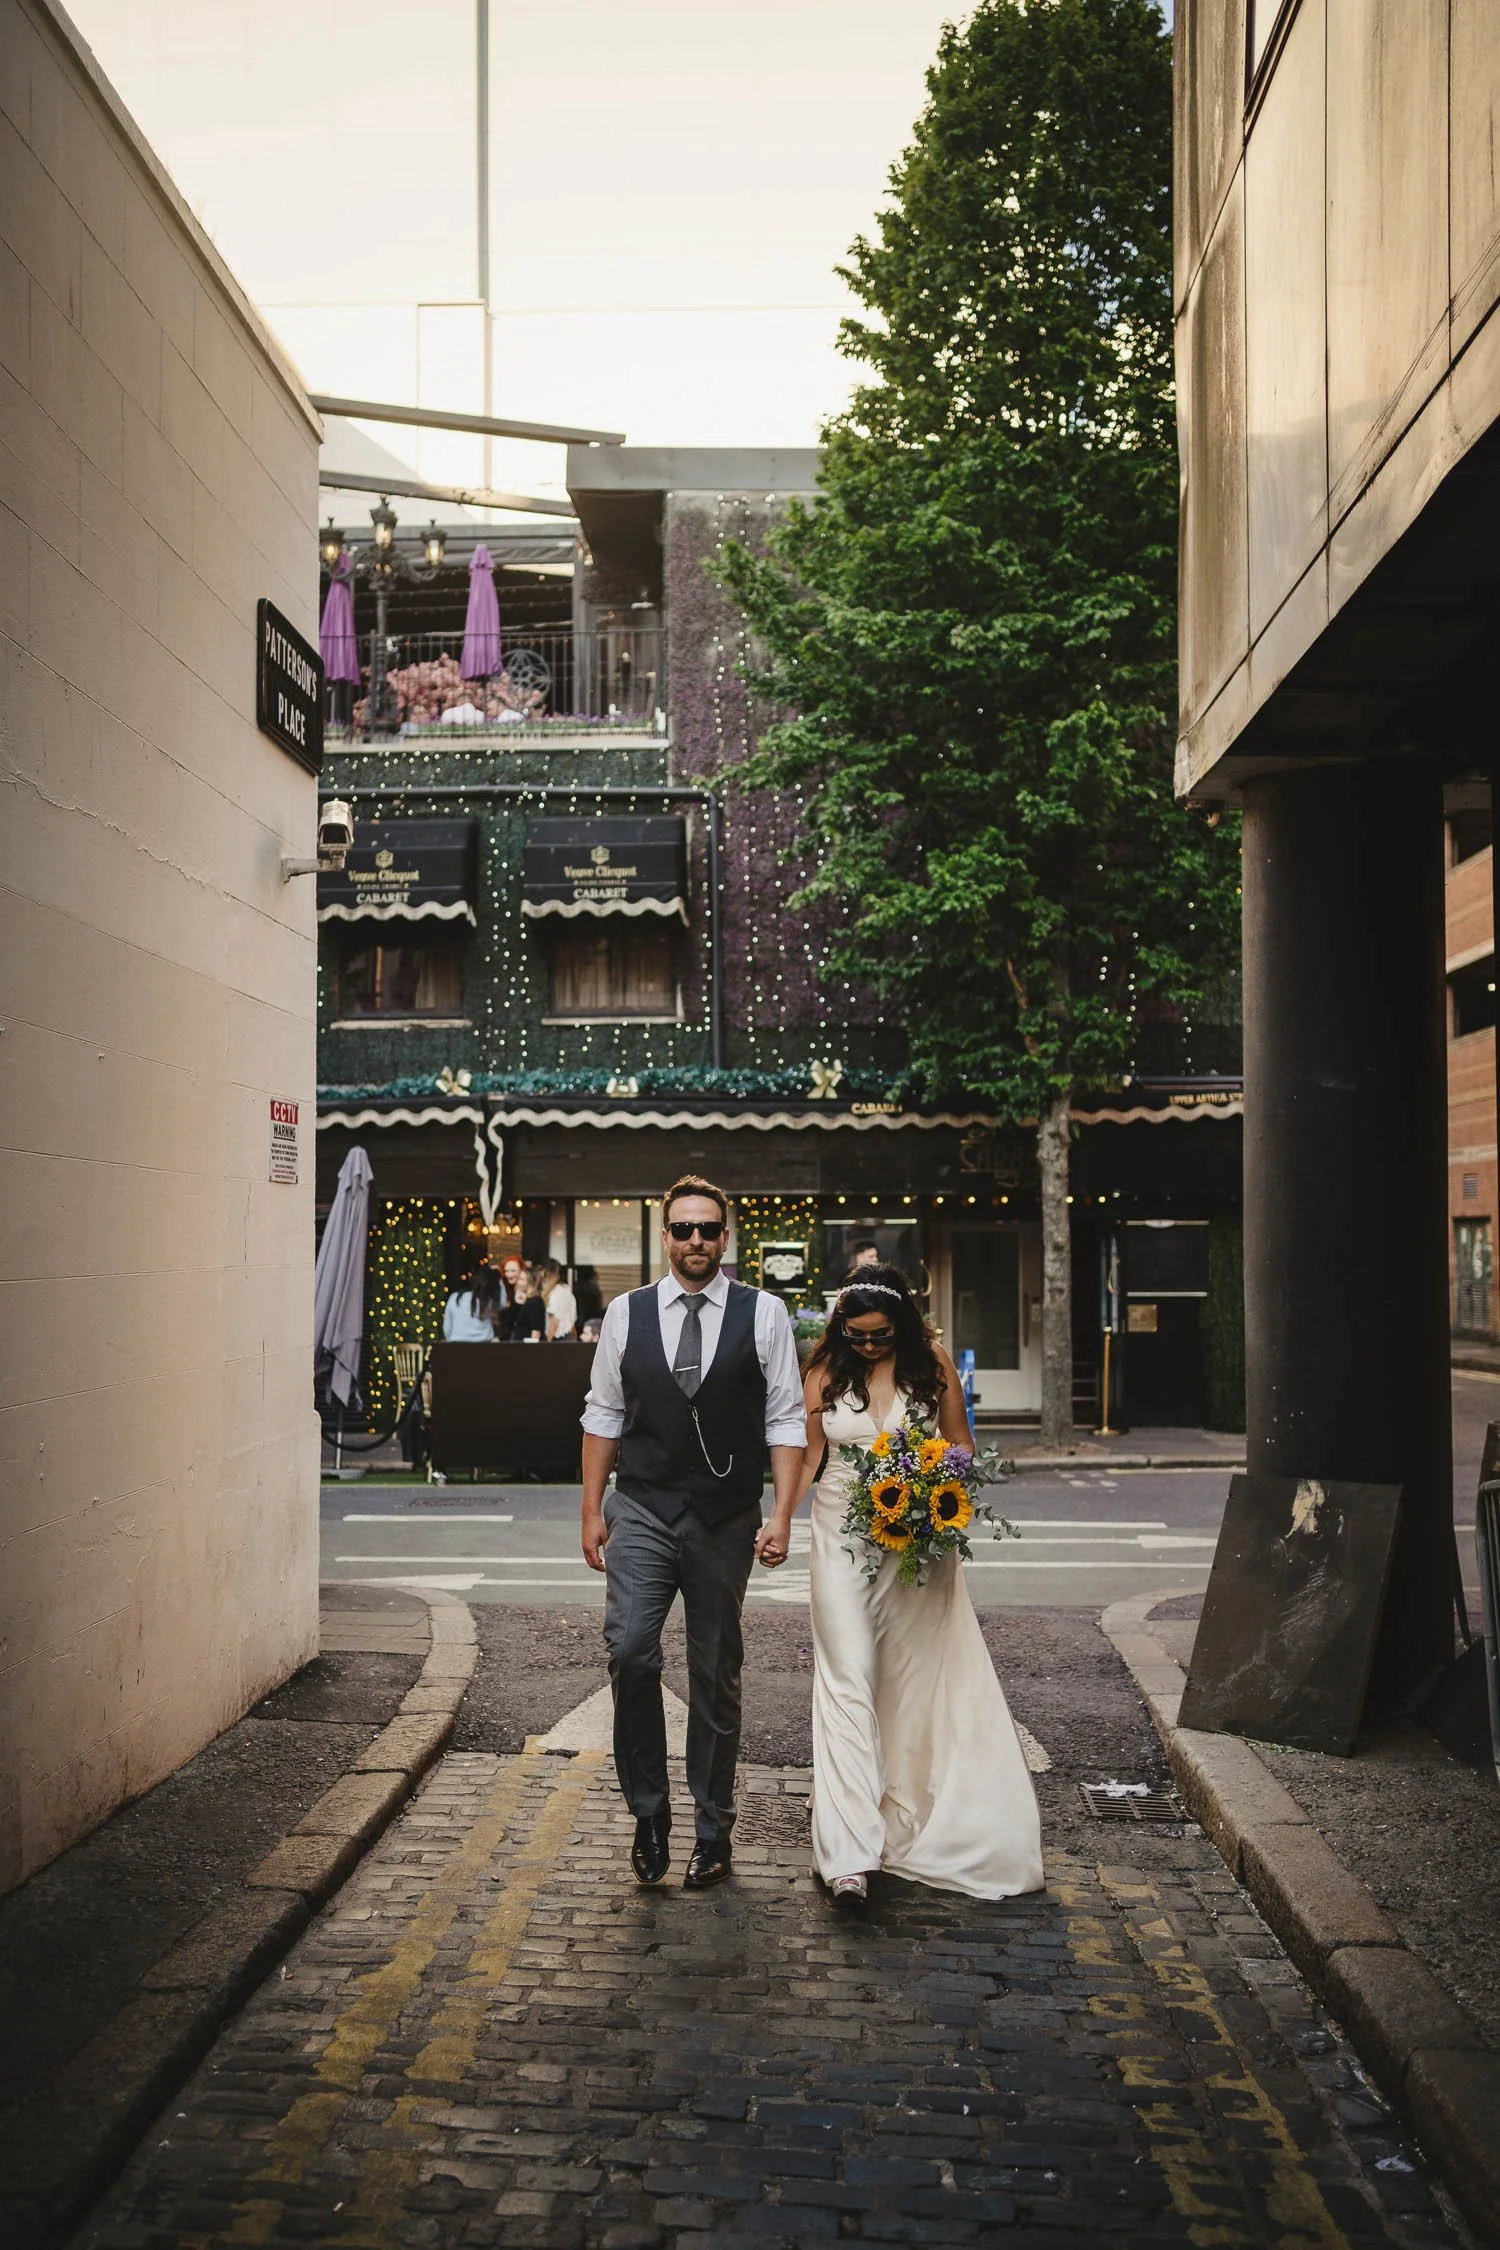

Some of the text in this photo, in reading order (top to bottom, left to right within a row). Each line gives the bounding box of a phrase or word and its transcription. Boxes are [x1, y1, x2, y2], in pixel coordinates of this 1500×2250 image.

[265, 621, 317, 702] PATTERSON'S
[278, 691, 306, 746] PLACE
[356, 892, 410, 904] CABARET
[573, 887, 628, 899] CABARET
[273, 1102, 296, 1123] CCTV
[273, 1123, 296, 1139] WARNING
